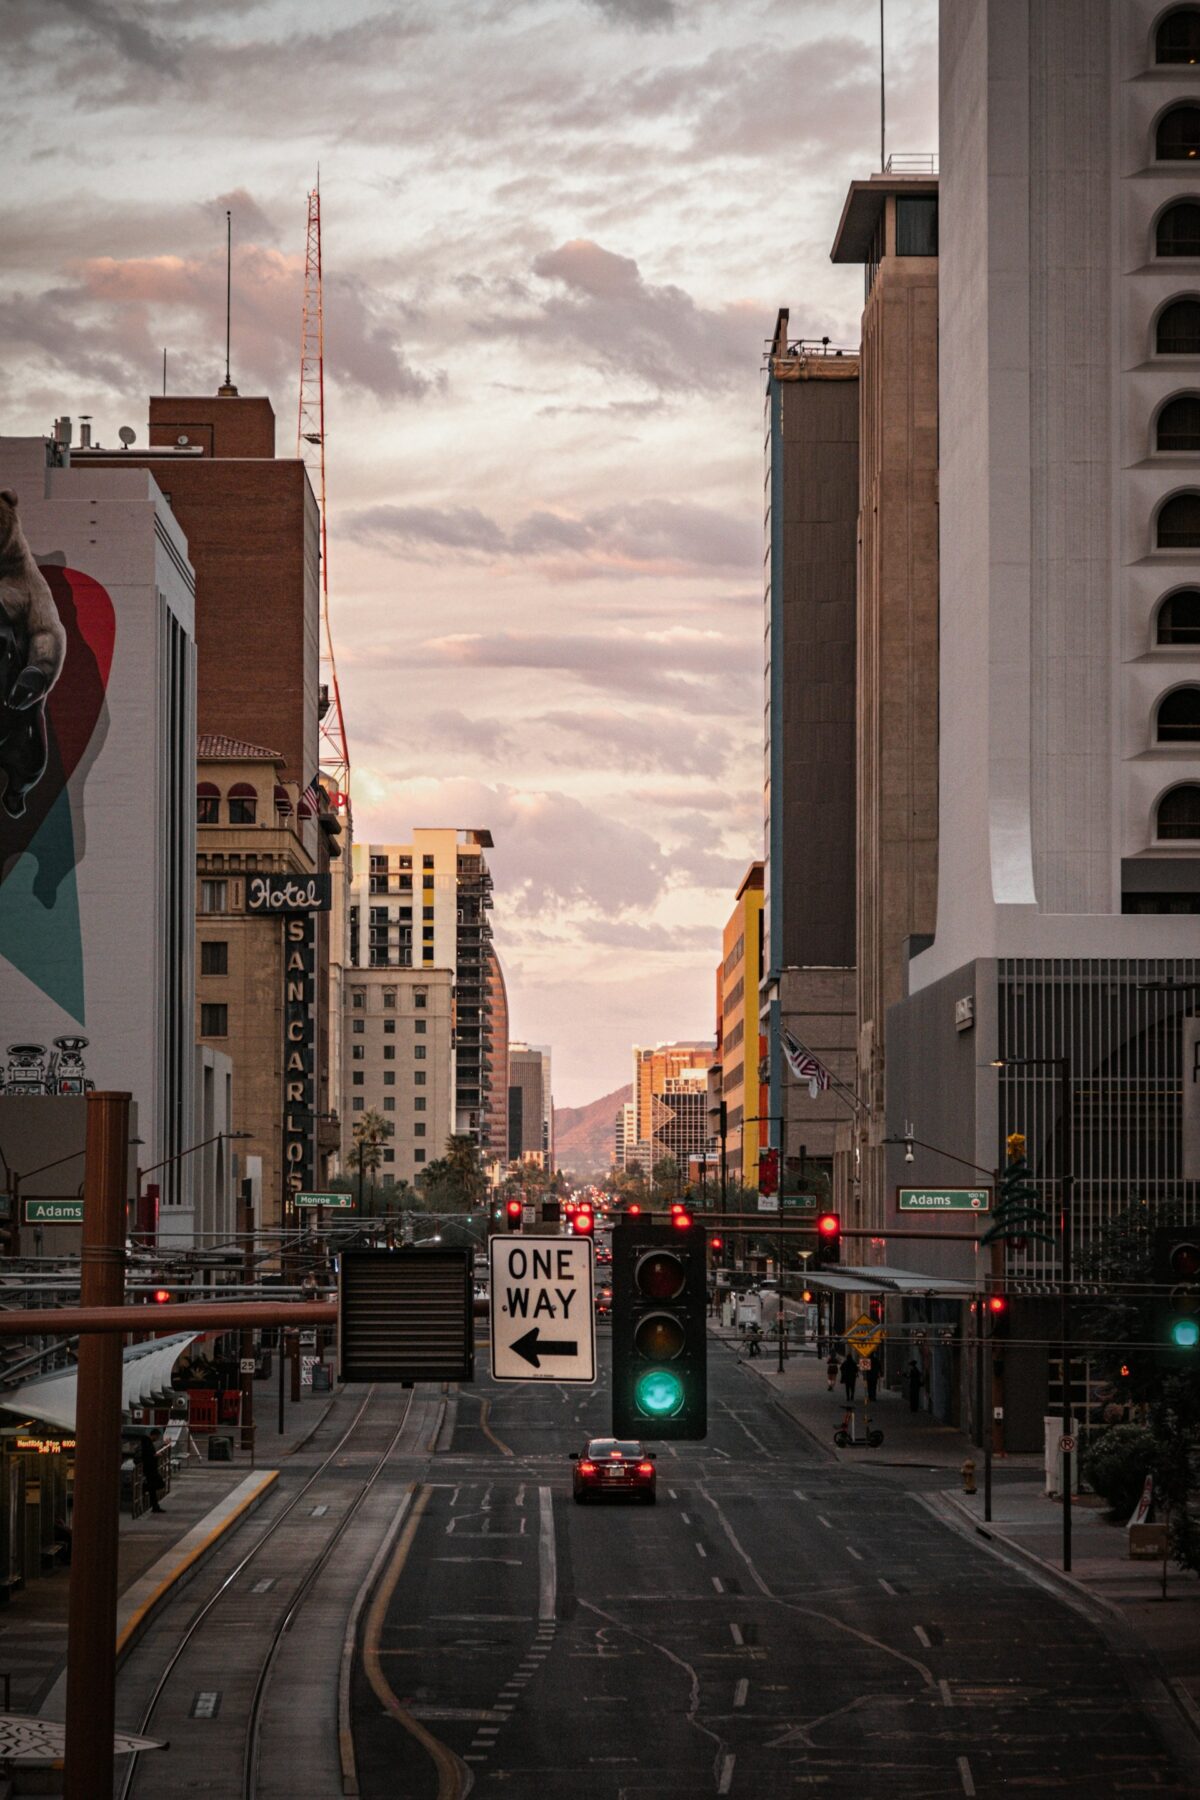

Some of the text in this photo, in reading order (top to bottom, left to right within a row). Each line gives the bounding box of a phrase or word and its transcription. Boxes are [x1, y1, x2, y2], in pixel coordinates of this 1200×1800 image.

[248, 878, 322, 909] Hotel
[286, 920, 305, 1192] SAN CARLOS
[300, 1196, 331, 1204] Monroe
[909, 1194, 951, 1205] Adams
[36, 1205, 82, 1217] Adams
[508, 1248, 575, 1280] ONE
[506, 1288, 577, 1319] WAY
[241, 1361, 254, 1370] 25
